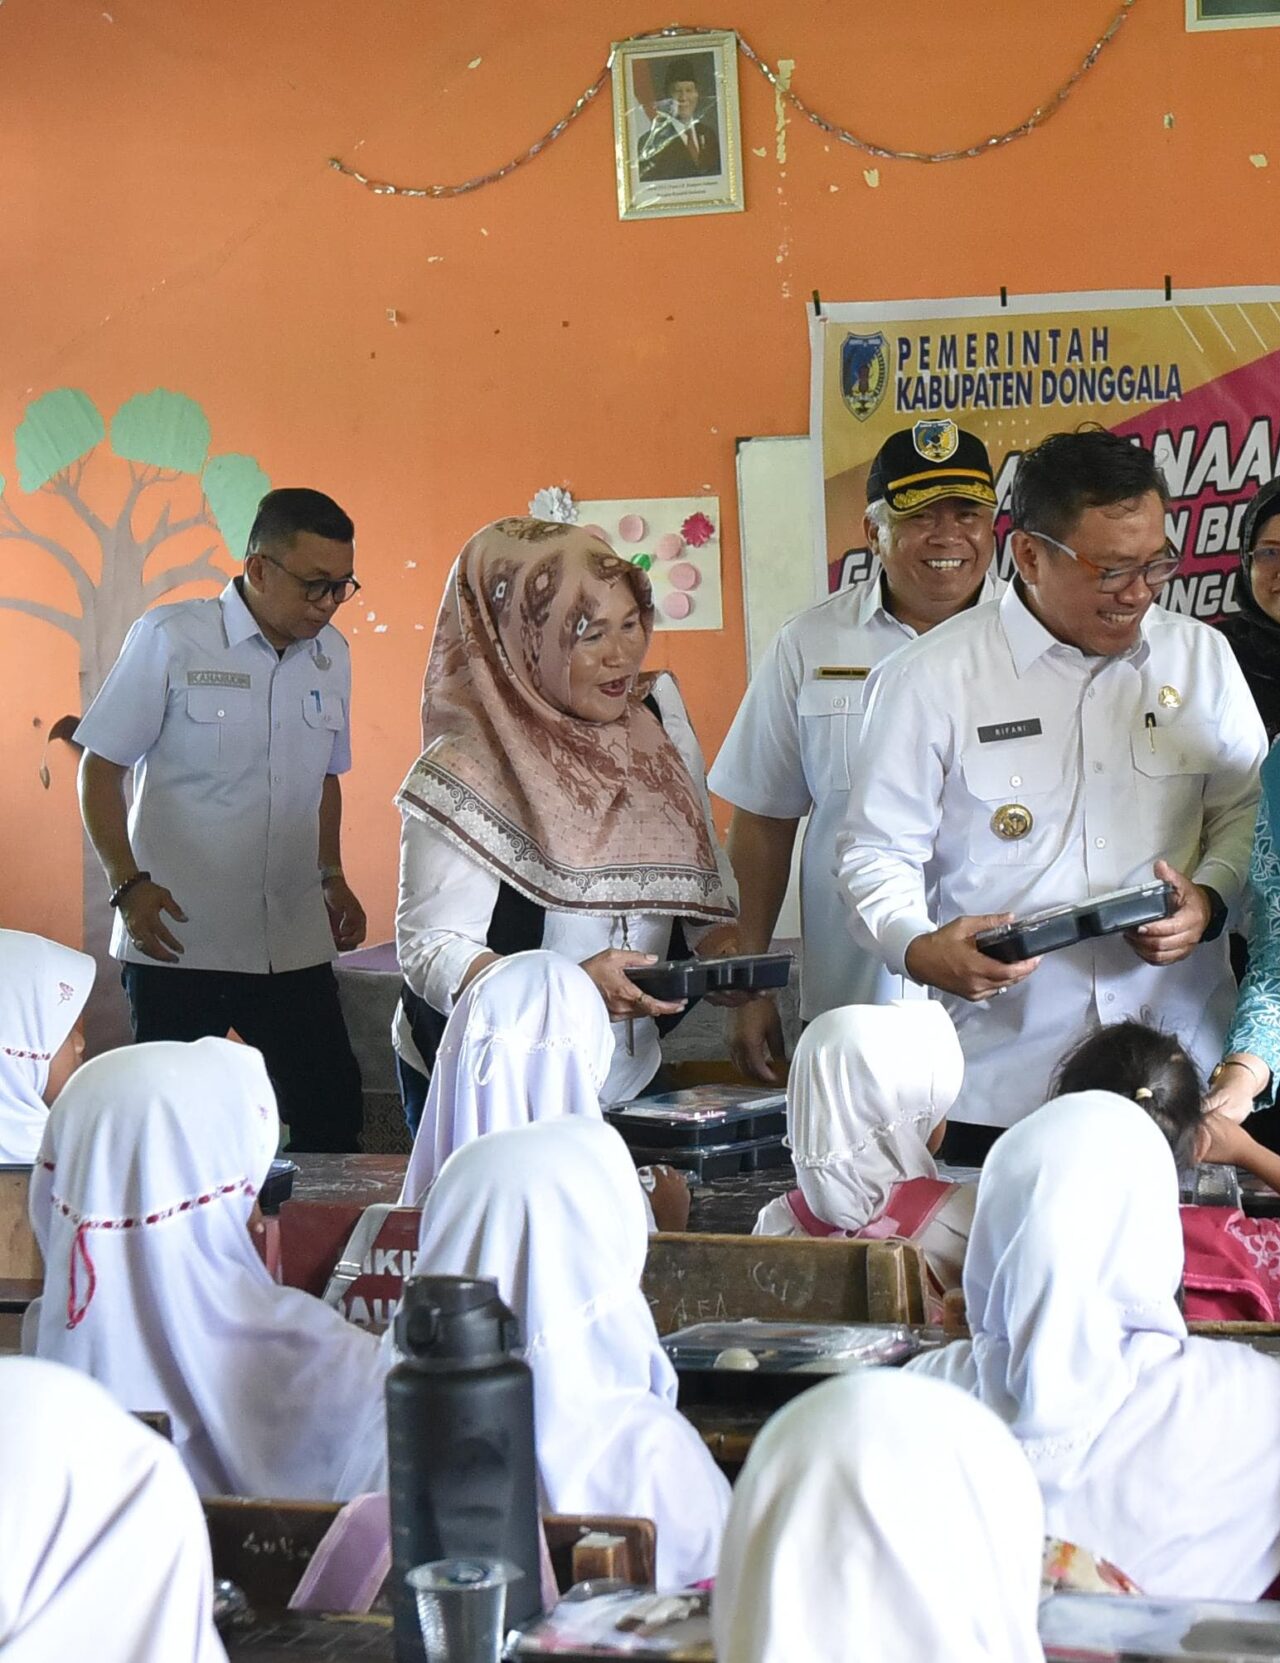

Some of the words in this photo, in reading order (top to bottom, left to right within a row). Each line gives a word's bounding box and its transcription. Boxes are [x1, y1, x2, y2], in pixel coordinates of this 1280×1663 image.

[897, 327, 1110, 371] PEMERINTAH
[896, 370, 1033, 411] KABUPATEN
[1044, 364, 1182, 405] DONGGALA
[994, 725, 1026, 736] RIFANI
